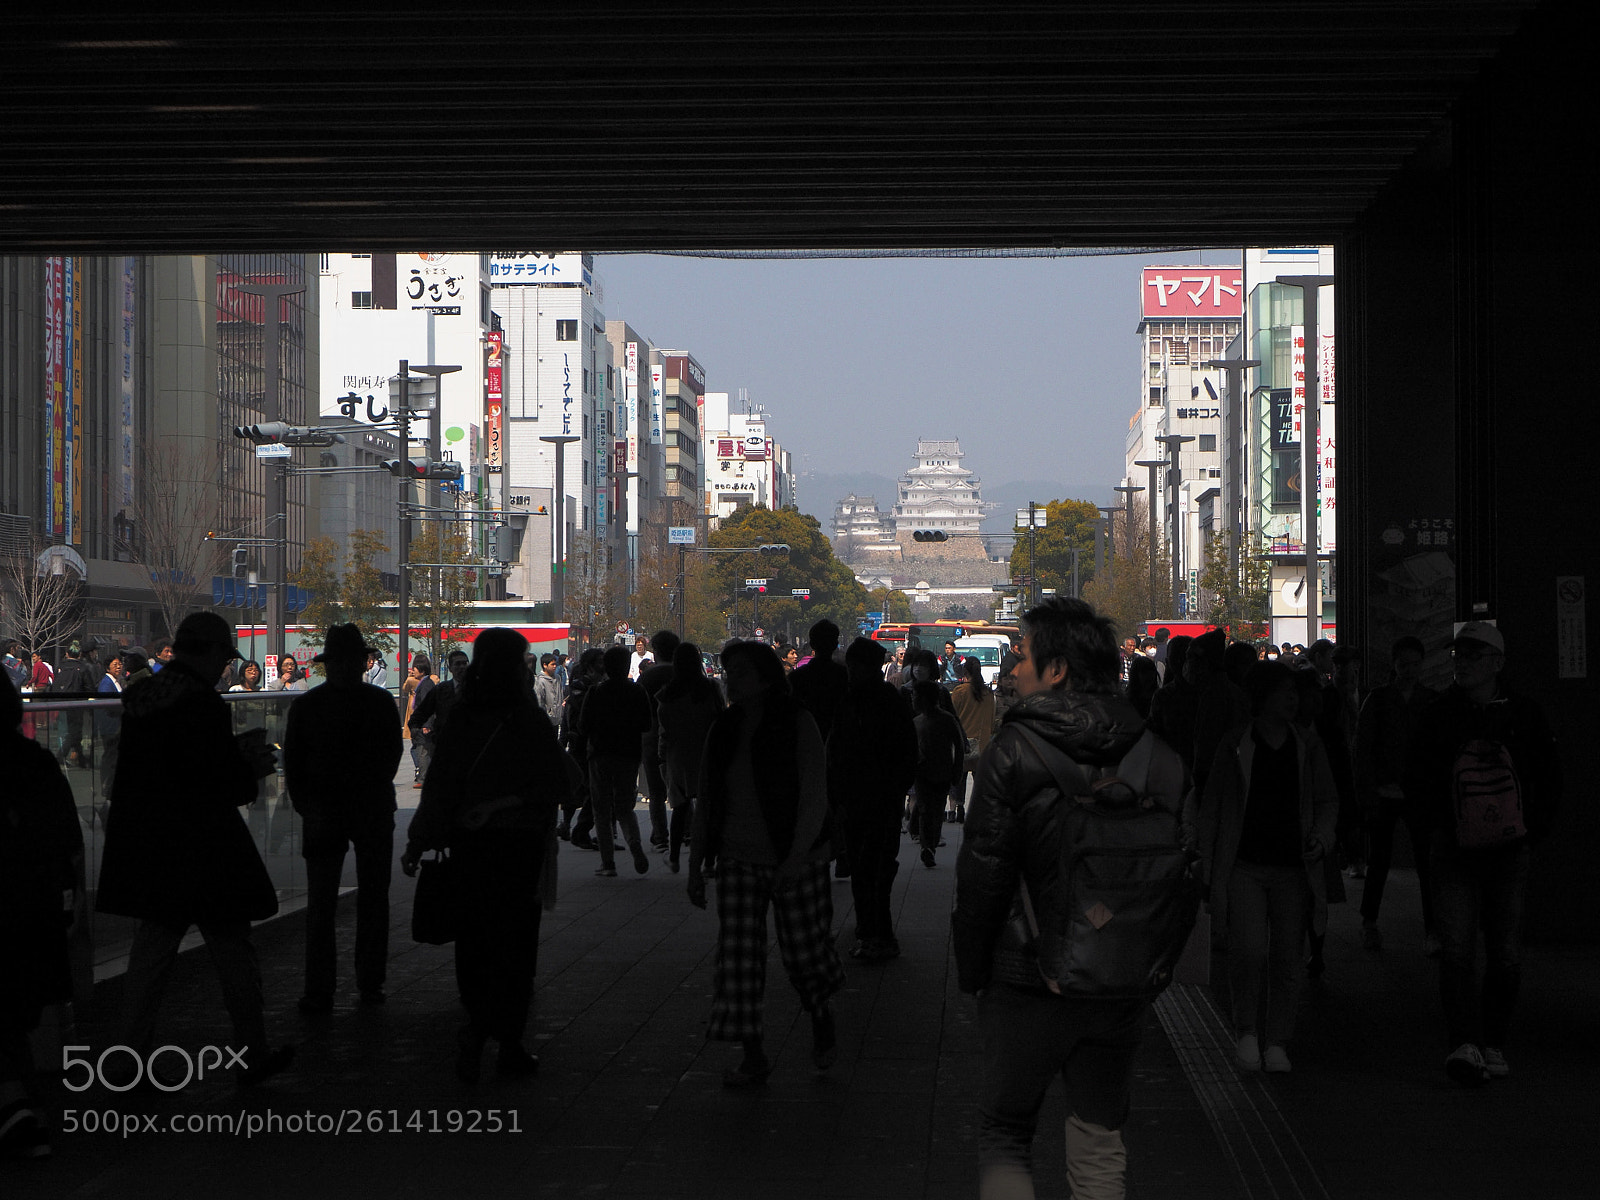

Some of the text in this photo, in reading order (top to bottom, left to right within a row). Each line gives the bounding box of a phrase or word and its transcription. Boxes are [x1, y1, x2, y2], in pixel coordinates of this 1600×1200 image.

[406, 269, 464, 302] うさぎ
[1147, 275, 1242, 307] ヤマト
[343, 375, 387, 389] 関西寿
[337, 391, 388, 423] すし
[652, 388, 661, 437] 第一生命
[1177, 408, 1221, 421] 岩井コス
[1325, 436, 1336, 510] 大和証券
[1408, 518, 1454, 529] ようこそ
[1416, 531, 1455, 545] 姫路
